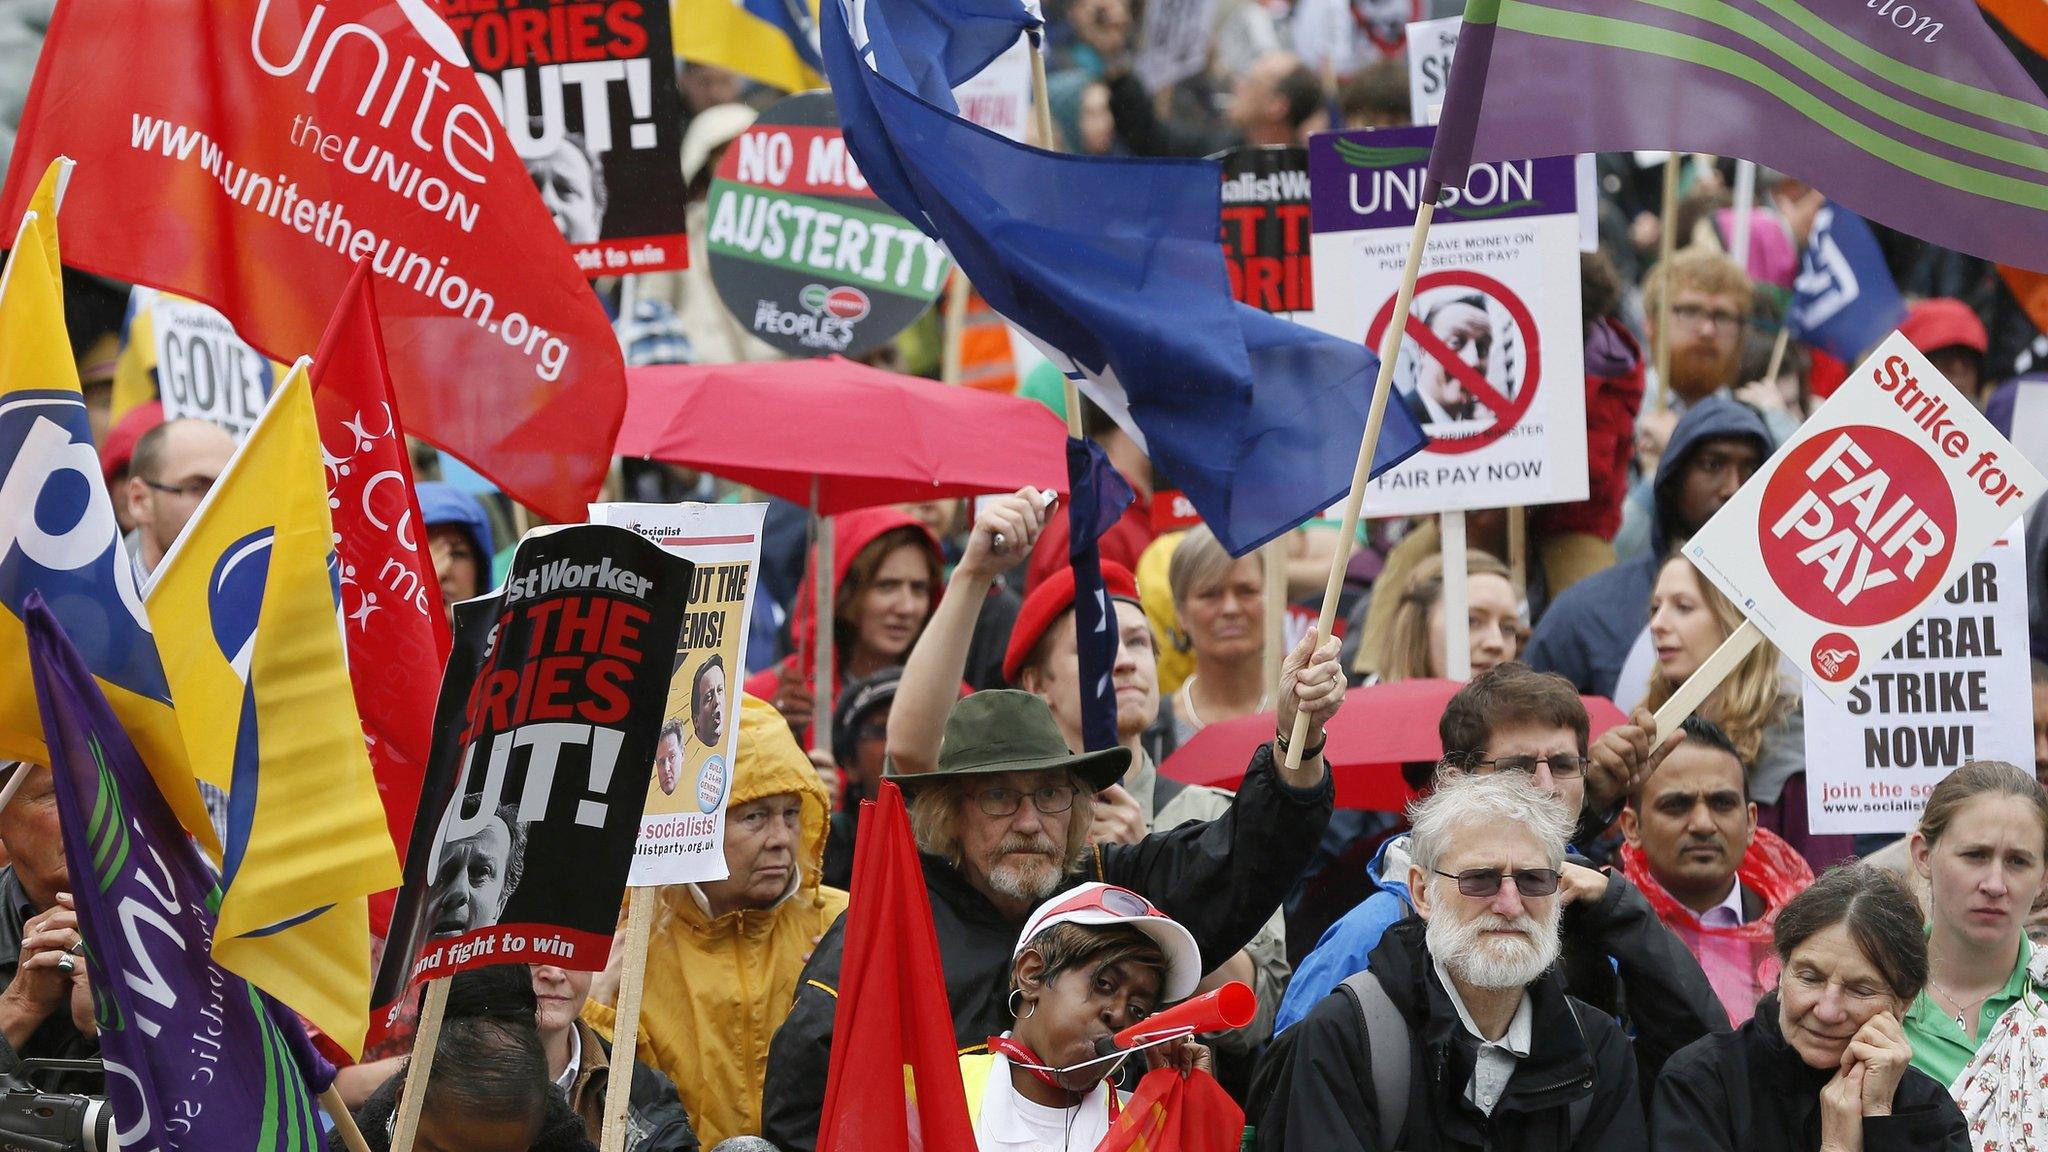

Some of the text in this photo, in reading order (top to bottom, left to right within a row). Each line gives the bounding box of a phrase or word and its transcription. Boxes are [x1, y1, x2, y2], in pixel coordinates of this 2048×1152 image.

[737, 131, 793, 186] NO
[131, 113, 569, 381] www.unitetheunion.org
[709, 190, 948, 292] AUSTERITY
[1428, 239, 1460, 251] SAVE
[1465, 234, 1512, 249] MONEY
[1515, 233, 1534, 245] ON
[1431, 250, 1484, 266] SECTOR
[1873, 354, 2025, 507] Strike for
[1378, 460, 1543, 491] FAIR PAY NOW
[1805, 431, 1946, 582] FAIR
[632, 523, 682, 536] Socialist
[1771, 488, 1898, 607] PAY
[717, 564, 749, 603] THE
[526, 596, 651, 664] THE
[1847, 671, 1989, 715] STRIKE
[1864, 726, 1975, 768] NOW!
[1822, 781, 1862, 802] join
[1870, 781, 1903, 798] the
[645, 815, 718, 839] socialists!
[447, 933, 496, 966] fight
[502, 932, 526, 951] to
[533, 934, 575, 958] win
